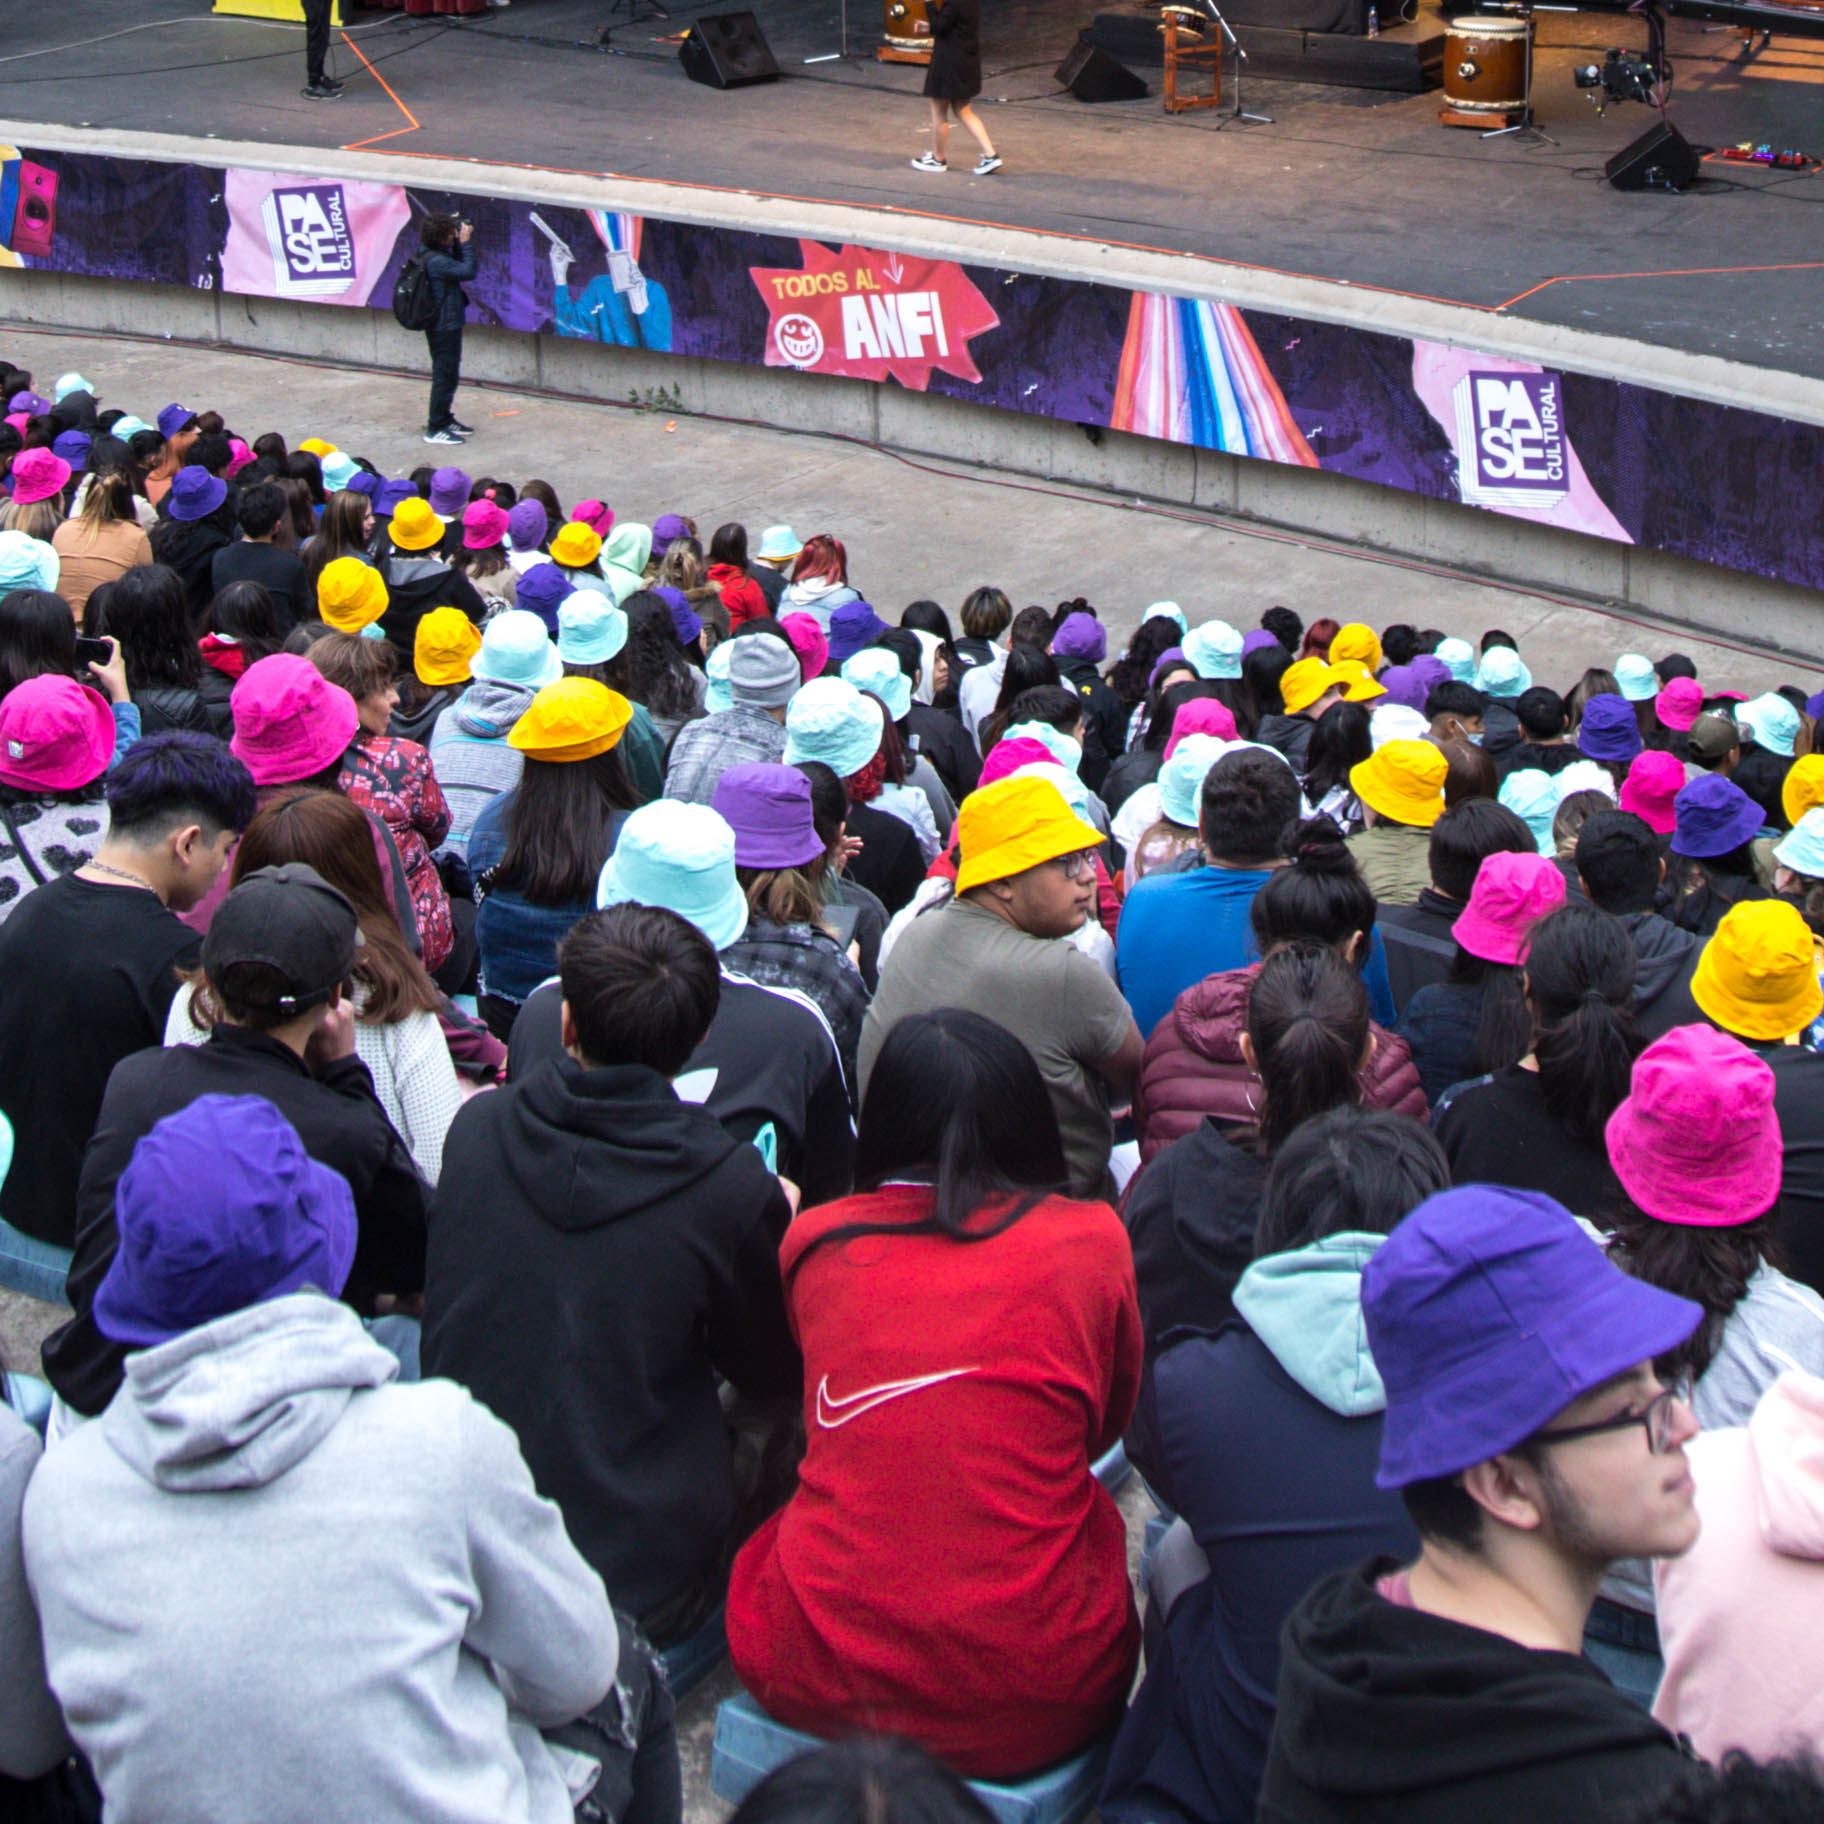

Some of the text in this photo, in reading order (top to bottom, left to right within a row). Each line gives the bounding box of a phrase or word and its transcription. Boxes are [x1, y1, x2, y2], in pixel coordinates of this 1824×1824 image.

[328, 191, 352, 270] CULTURAL
[772, 268, 880, 300] TODOS AL
[841, 291, 949, 360] ANFI
[1539, 381, 1564, 481] CULTURAL
